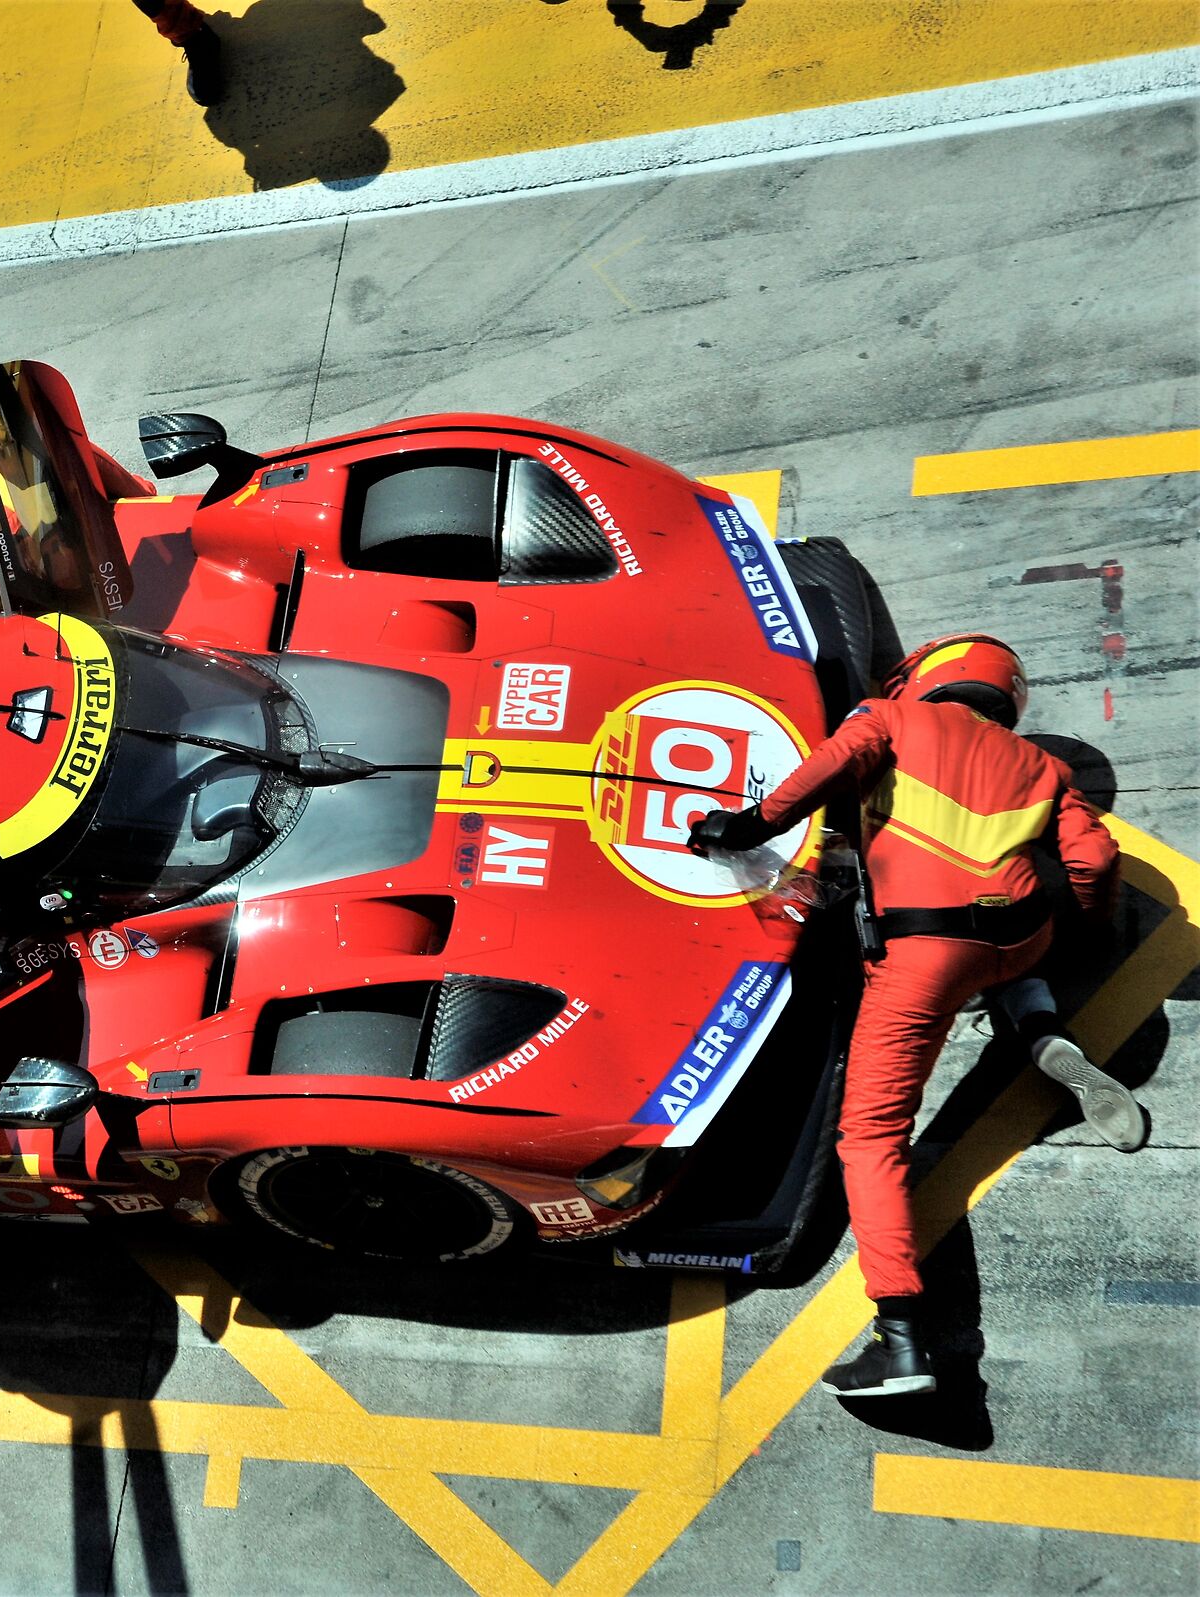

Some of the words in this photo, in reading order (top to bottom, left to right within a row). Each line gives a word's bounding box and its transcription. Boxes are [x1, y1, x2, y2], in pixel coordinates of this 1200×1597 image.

[538, 443, 590, 493] MILLE
[585, 493, 643, 577] RICHARD
[714, 510, 737, 542] PELZER
[726, 508, 749, 539] GROUP
[741, 563, 801, 649] ADLER
[503, 667, 530, 726] HYPER
[525, 668, 565, 727] CAR
[50, 656, 112, 799] Ferrari
[599, 728, 633, 826] DHL
[642, 727, 733, 846] 50
[481, 825, 551, 887] HY
[732, 966, 762, 1002] PELZER
[745, 974, 774, 1010] GROUP
[448, 1042, 540, 1105] RICHARD
[536, 997, 591, 1048] MILLE
[657, 1025, 736, 1125] ADLER
[647, 1251, 744, 1269] MICHELIN
